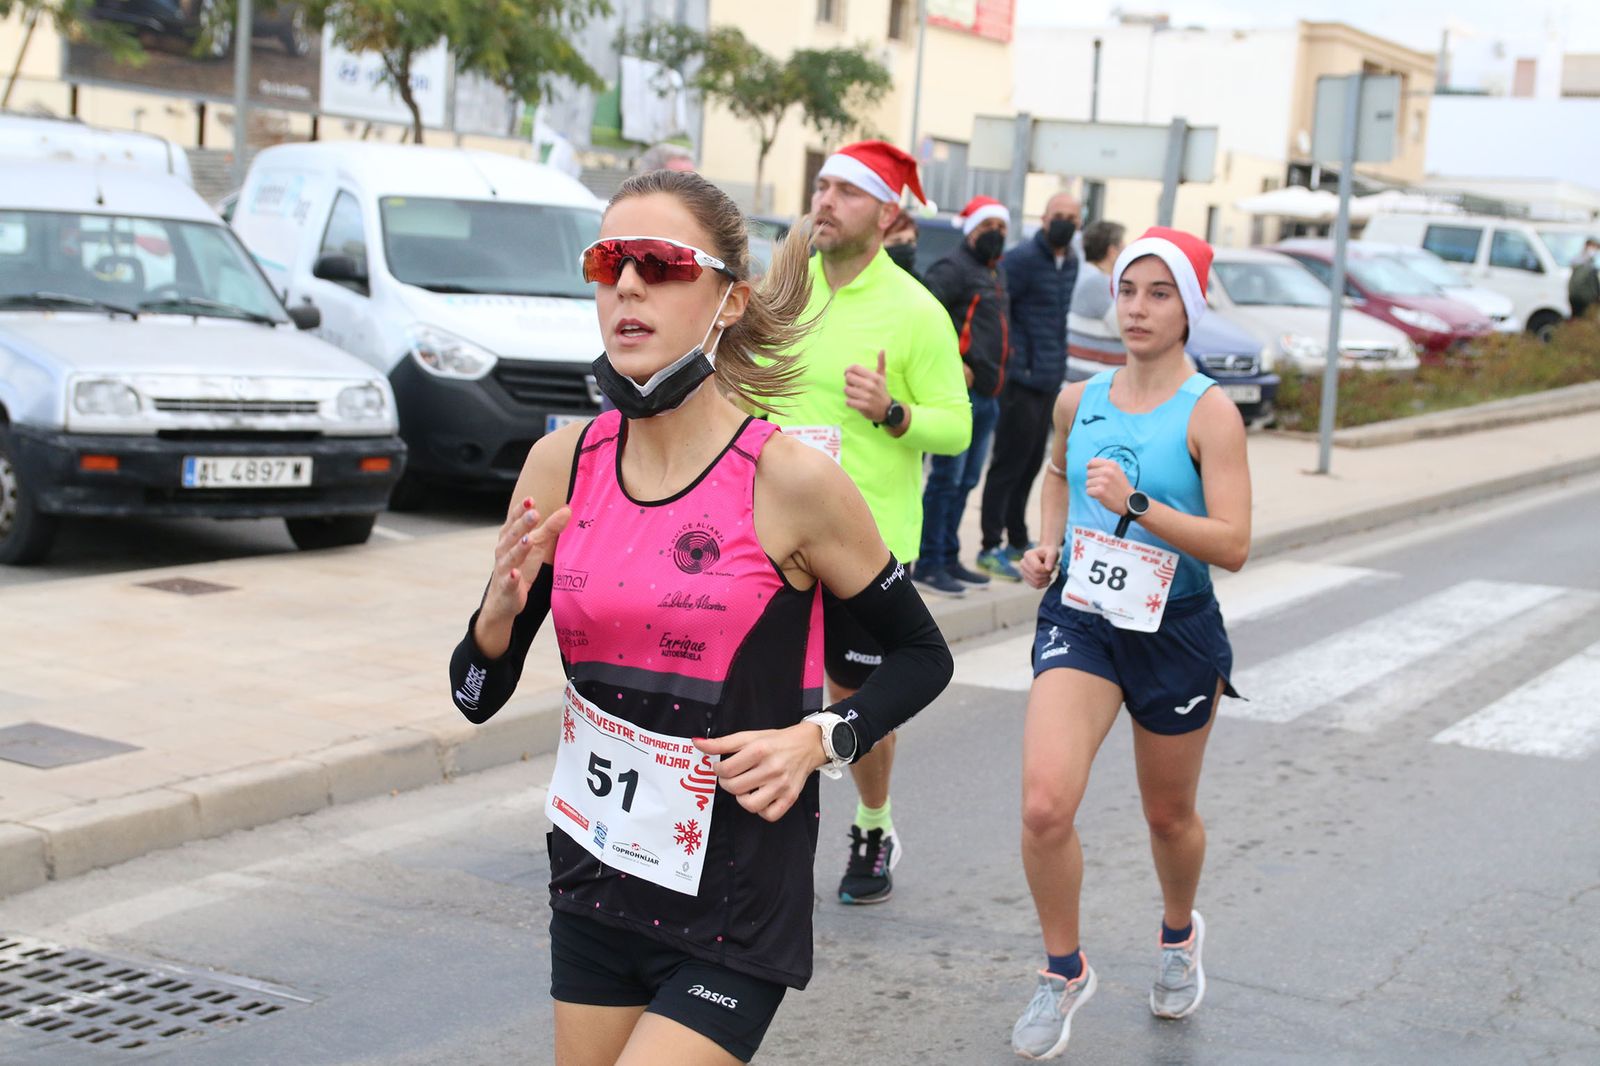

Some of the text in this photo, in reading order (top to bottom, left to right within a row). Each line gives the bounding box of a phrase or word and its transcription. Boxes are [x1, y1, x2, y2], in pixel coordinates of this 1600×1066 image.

[230, 461, 287, 481] 4897
[671, 523, 693, 544] DULCE
[696, 522, 725, 543] ALIANZA
[1088, 560, 1128, 591] 58
[659, 632, 708, 652] Enrique
[661, 649, 702, 661] AUTOESCUELA
[572, 693, 585, 713] SAN
[586, 707, 635, 742] SILVESTRE
[638, 733, 680, 752] COMARCA
[682, 745, 694, 755] DE
[655, 752, 691, 770] NÍJAR
[586, 751, 639, 814] 51
[700, 989, 739, 1009] asics
